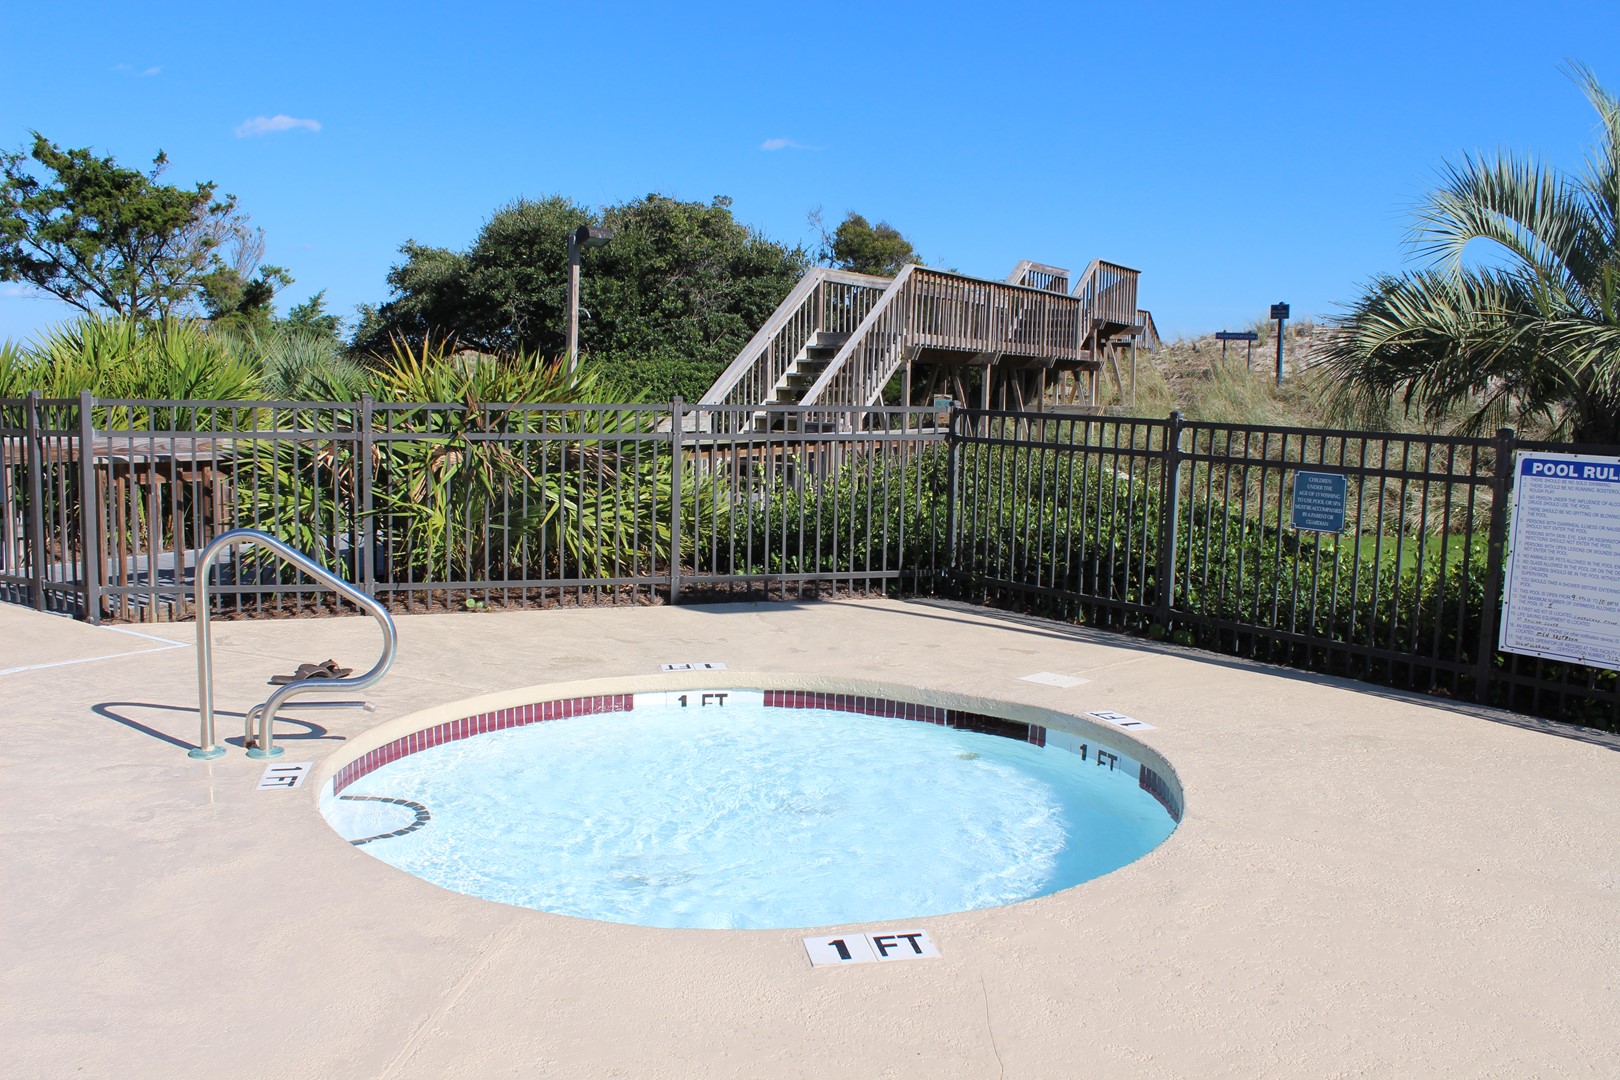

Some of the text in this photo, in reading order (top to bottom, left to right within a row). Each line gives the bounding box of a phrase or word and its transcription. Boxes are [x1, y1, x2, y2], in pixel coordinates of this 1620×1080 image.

[1532, 462, 1620, 480] POOL RUL
[678, 694, 728, 707] 1 FT
[1080, 744, 1118, 771] 1 FT
[828, 933, 923, 960] 1 FT
